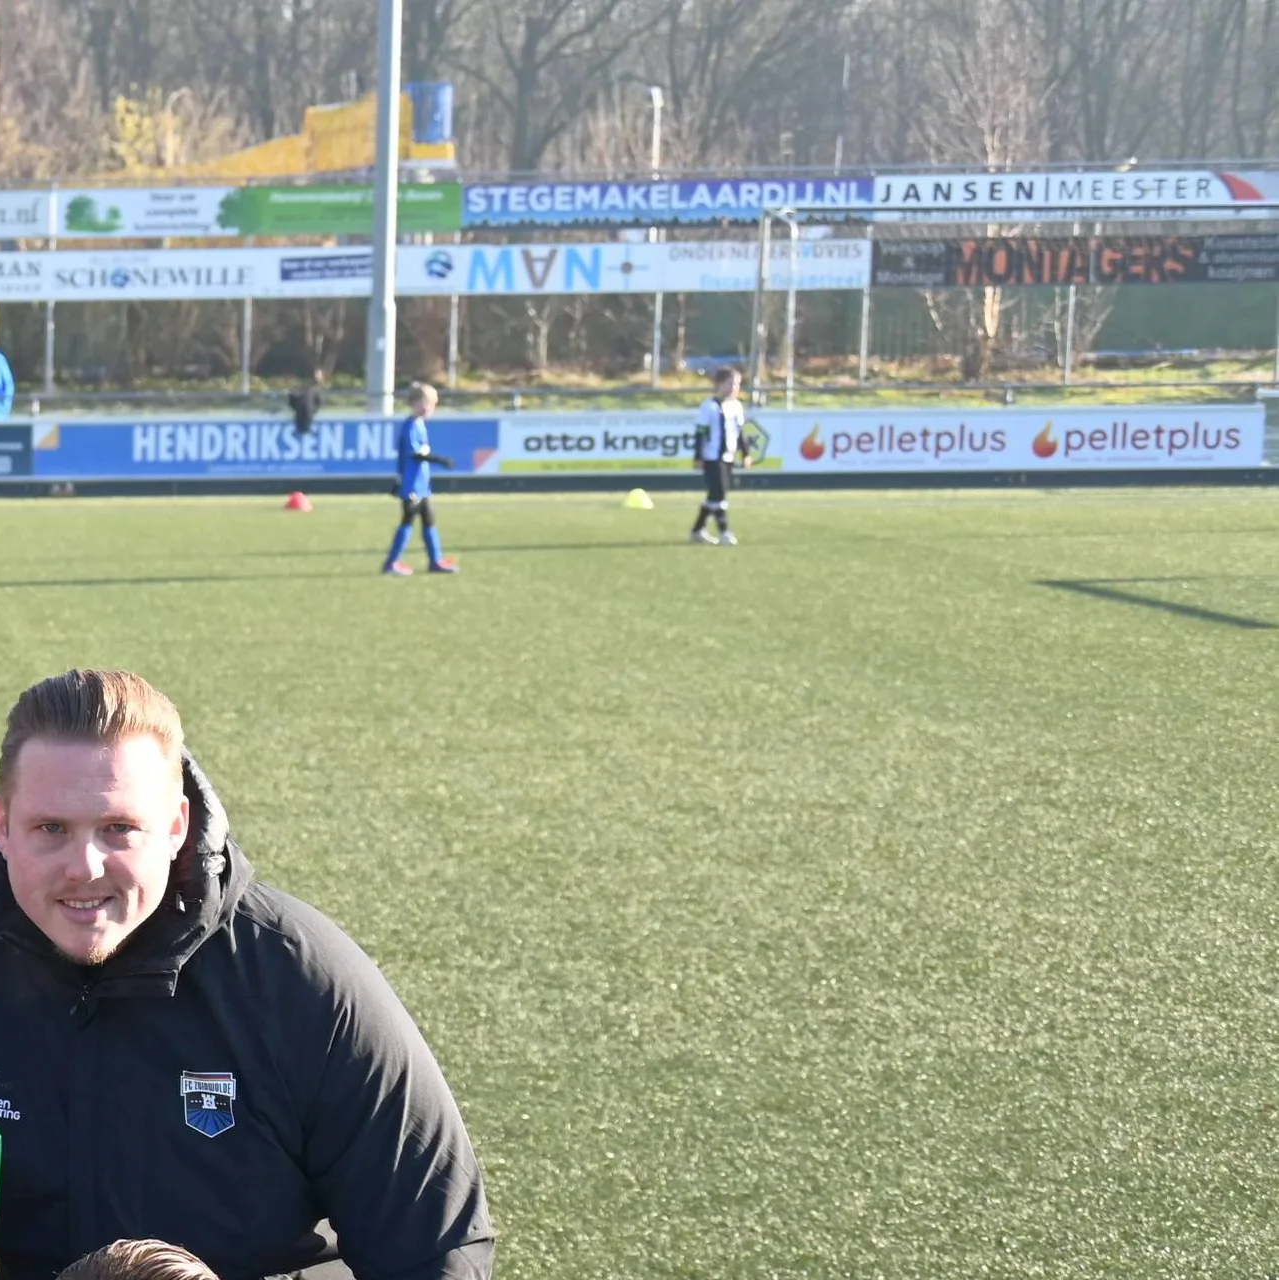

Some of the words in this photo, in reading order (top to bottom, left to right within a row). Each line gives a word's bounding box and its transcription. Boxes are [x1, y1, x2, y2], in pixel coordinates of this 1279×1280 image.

[467, 182, 872, 214] STEGEMAKELAARDIJ.NL
[882, 178, 1036, 203] JANSEN
[1059, 178, 1213, 200] MEESTER
[133, 424, 399, 463] HENDRIKSEN.NL
[523, 431, 596, 453] otto
[831, 423, 1007, 461] pelletplus
[1064, 420, 1242, 457] pelletplus
